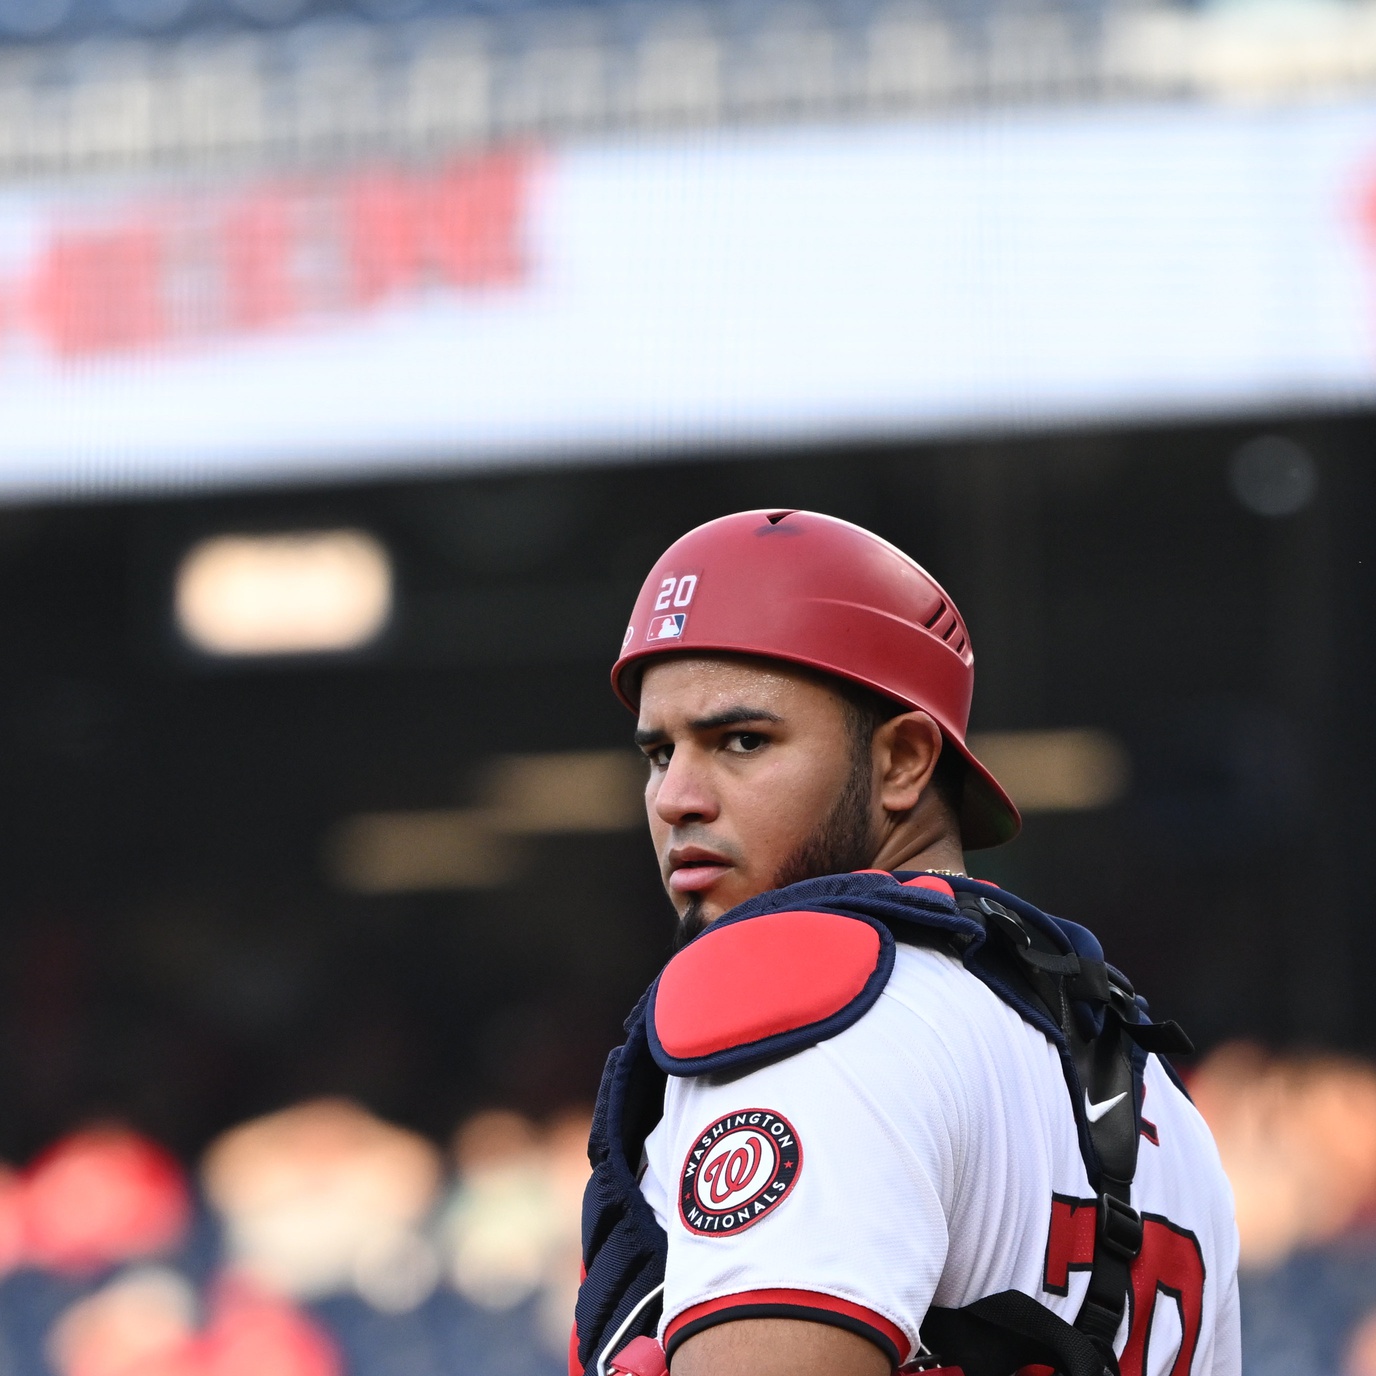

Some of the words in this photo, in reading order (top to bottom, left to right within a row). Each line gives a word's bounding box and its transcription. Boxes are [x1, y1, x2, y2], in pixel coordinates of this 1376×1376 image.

[654, 574, 698, 611] 20
[685, 1112, 794, 1178] WASHINGTON
[703, 1136, 763, 1204] W
[687, 1180, 787, 1230] NATIONALS
